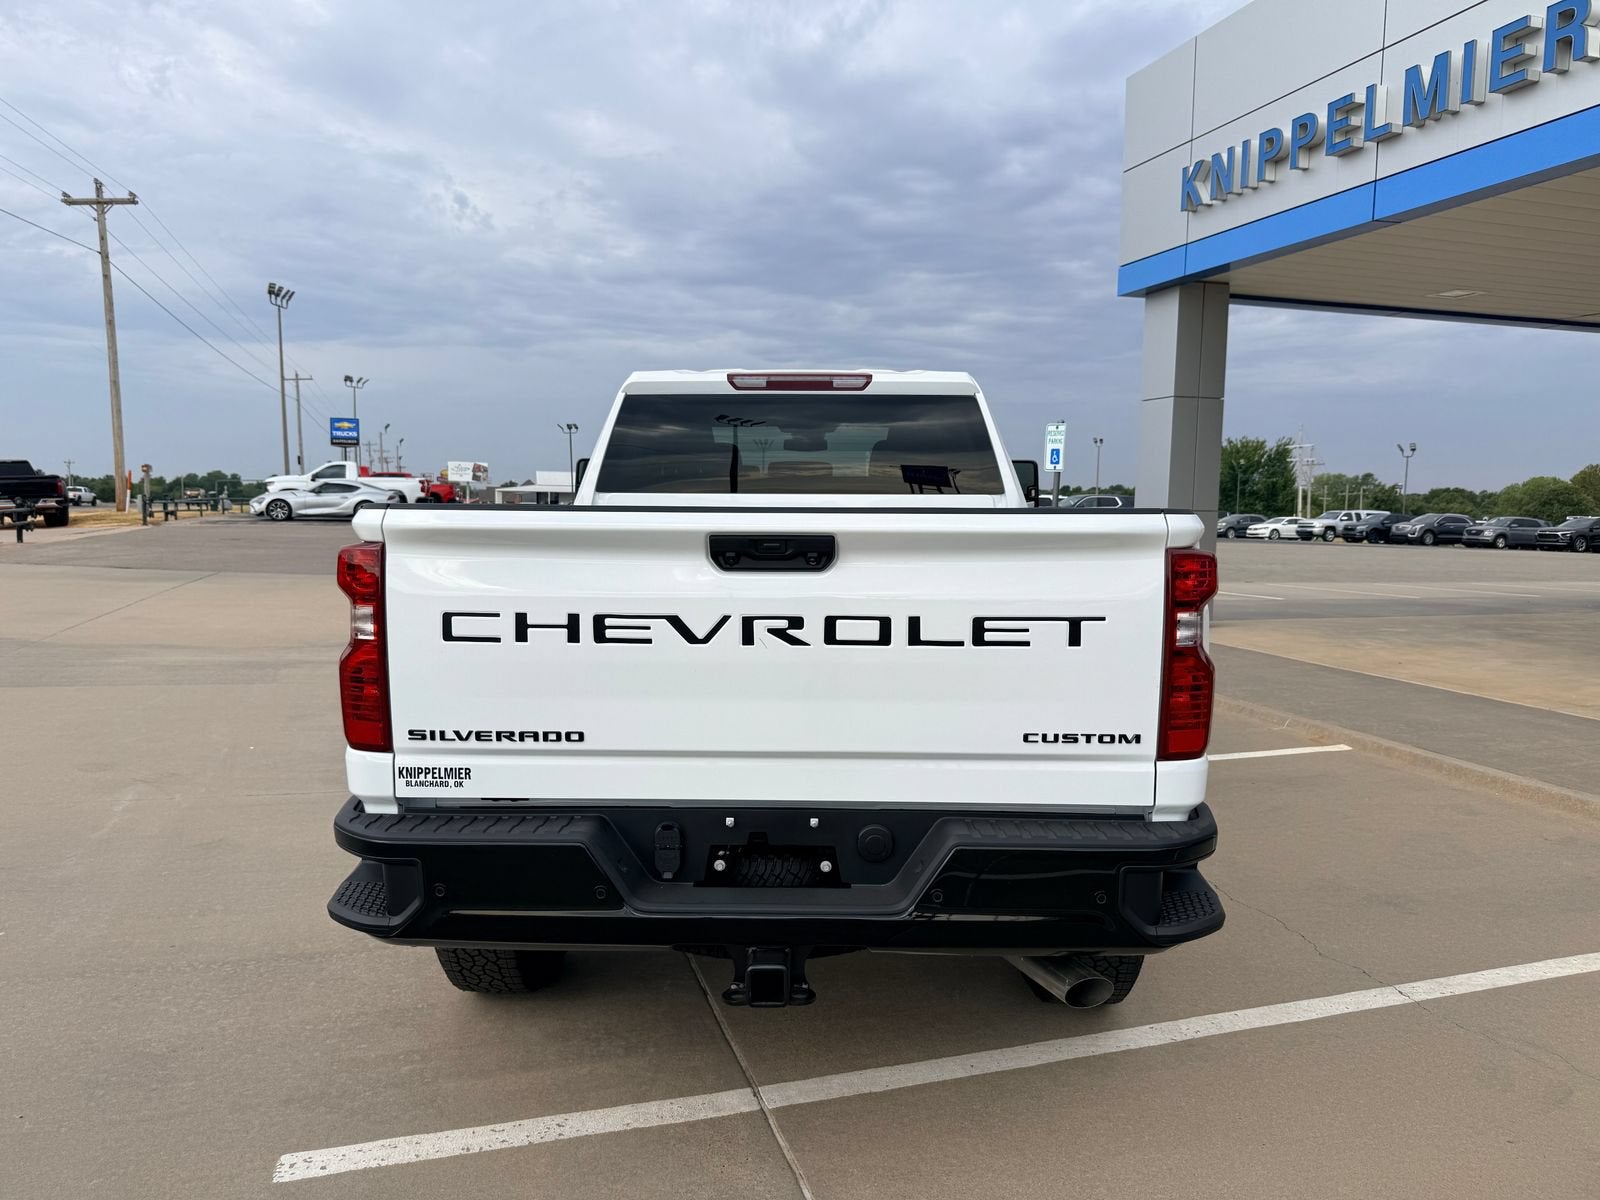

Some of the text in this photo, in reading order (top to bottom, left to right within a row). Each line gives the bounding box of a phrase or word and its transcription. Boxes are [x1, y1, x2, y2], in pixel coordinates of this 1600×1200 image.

[1181, 0, 1599, 212] KNIPPELMIER
[442, 611, 1106, 647] CHEVROLET
[408, 729, 585, 742] SILVERADO
[1023, 732, 1141, 744] CUSTOM
[398, 766, 472, 780] KNIPPELMIER
[405, 780, 464, 788] BLANCHARD, OK
